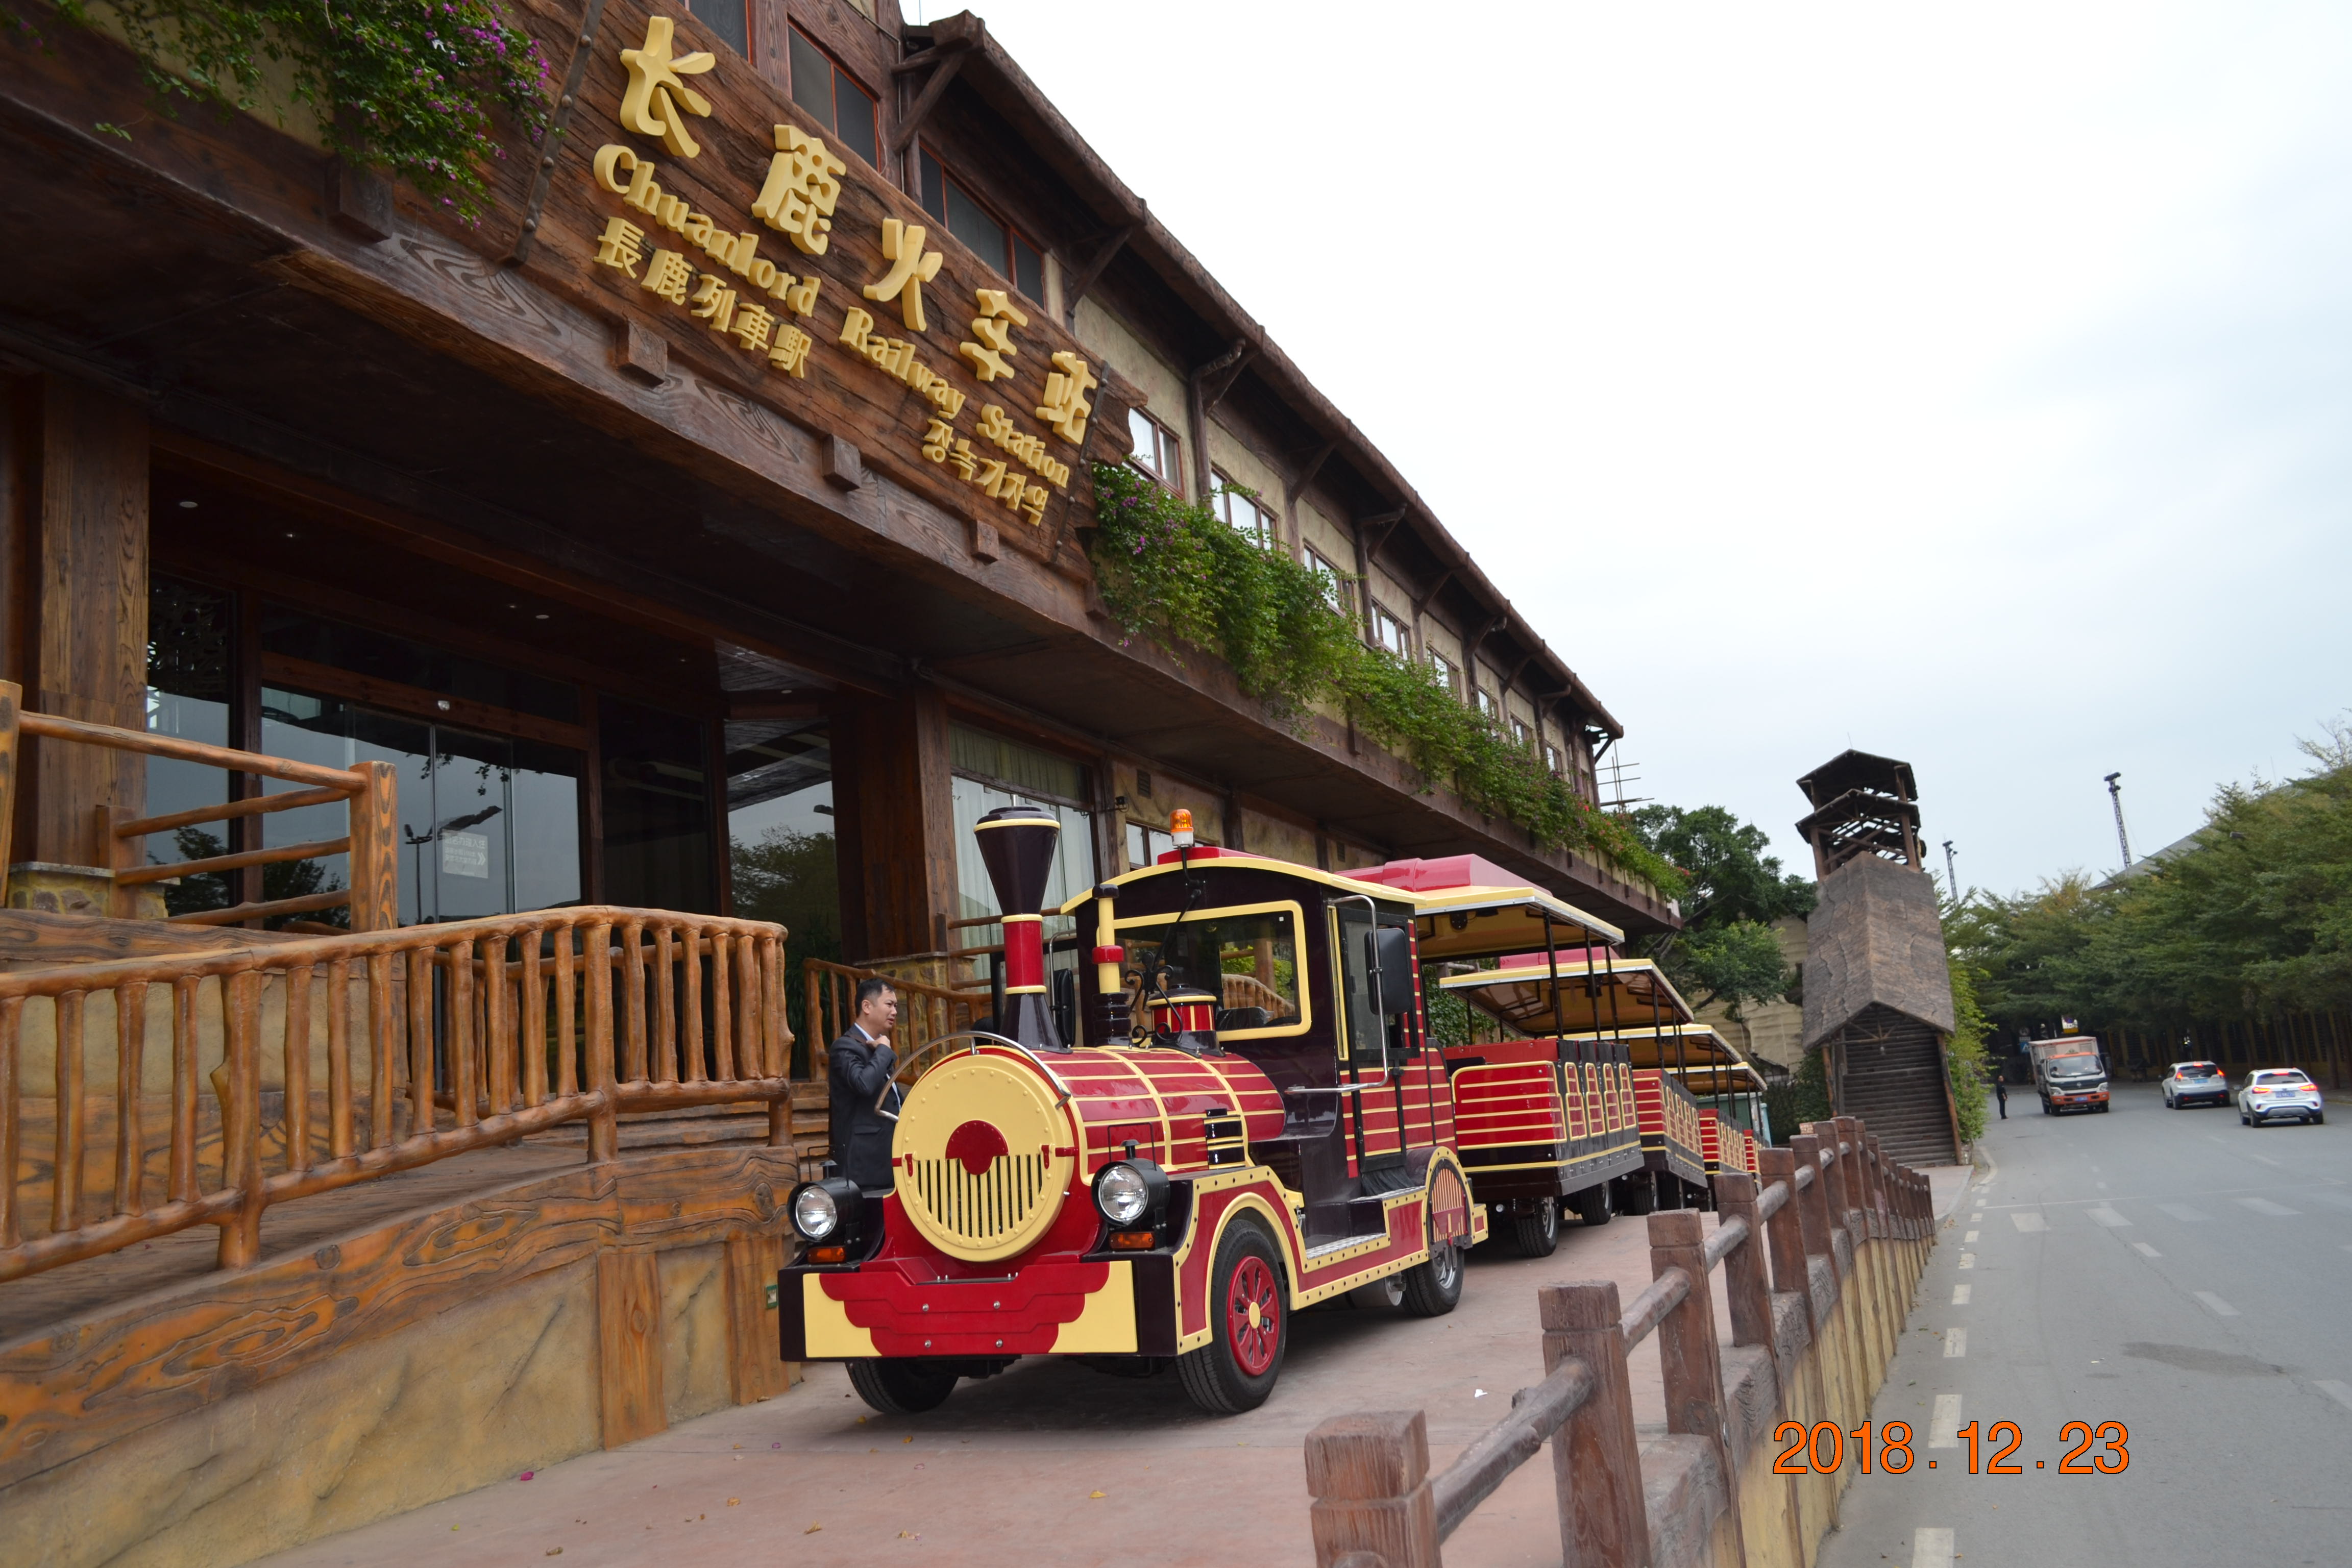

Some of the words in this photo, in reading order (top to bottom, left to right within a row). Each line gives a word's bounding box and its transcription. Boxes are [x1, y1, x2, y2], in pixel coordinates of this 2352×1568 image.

[593, 216, 813, 379] 長鹿列車駅
[594, 144, 821, 317] Chuanlord
[839, 306, 966, 420] Railway
[975, 405, 1070, 488] Station
[620, 16, 1097, 446] 长鹿火车站
